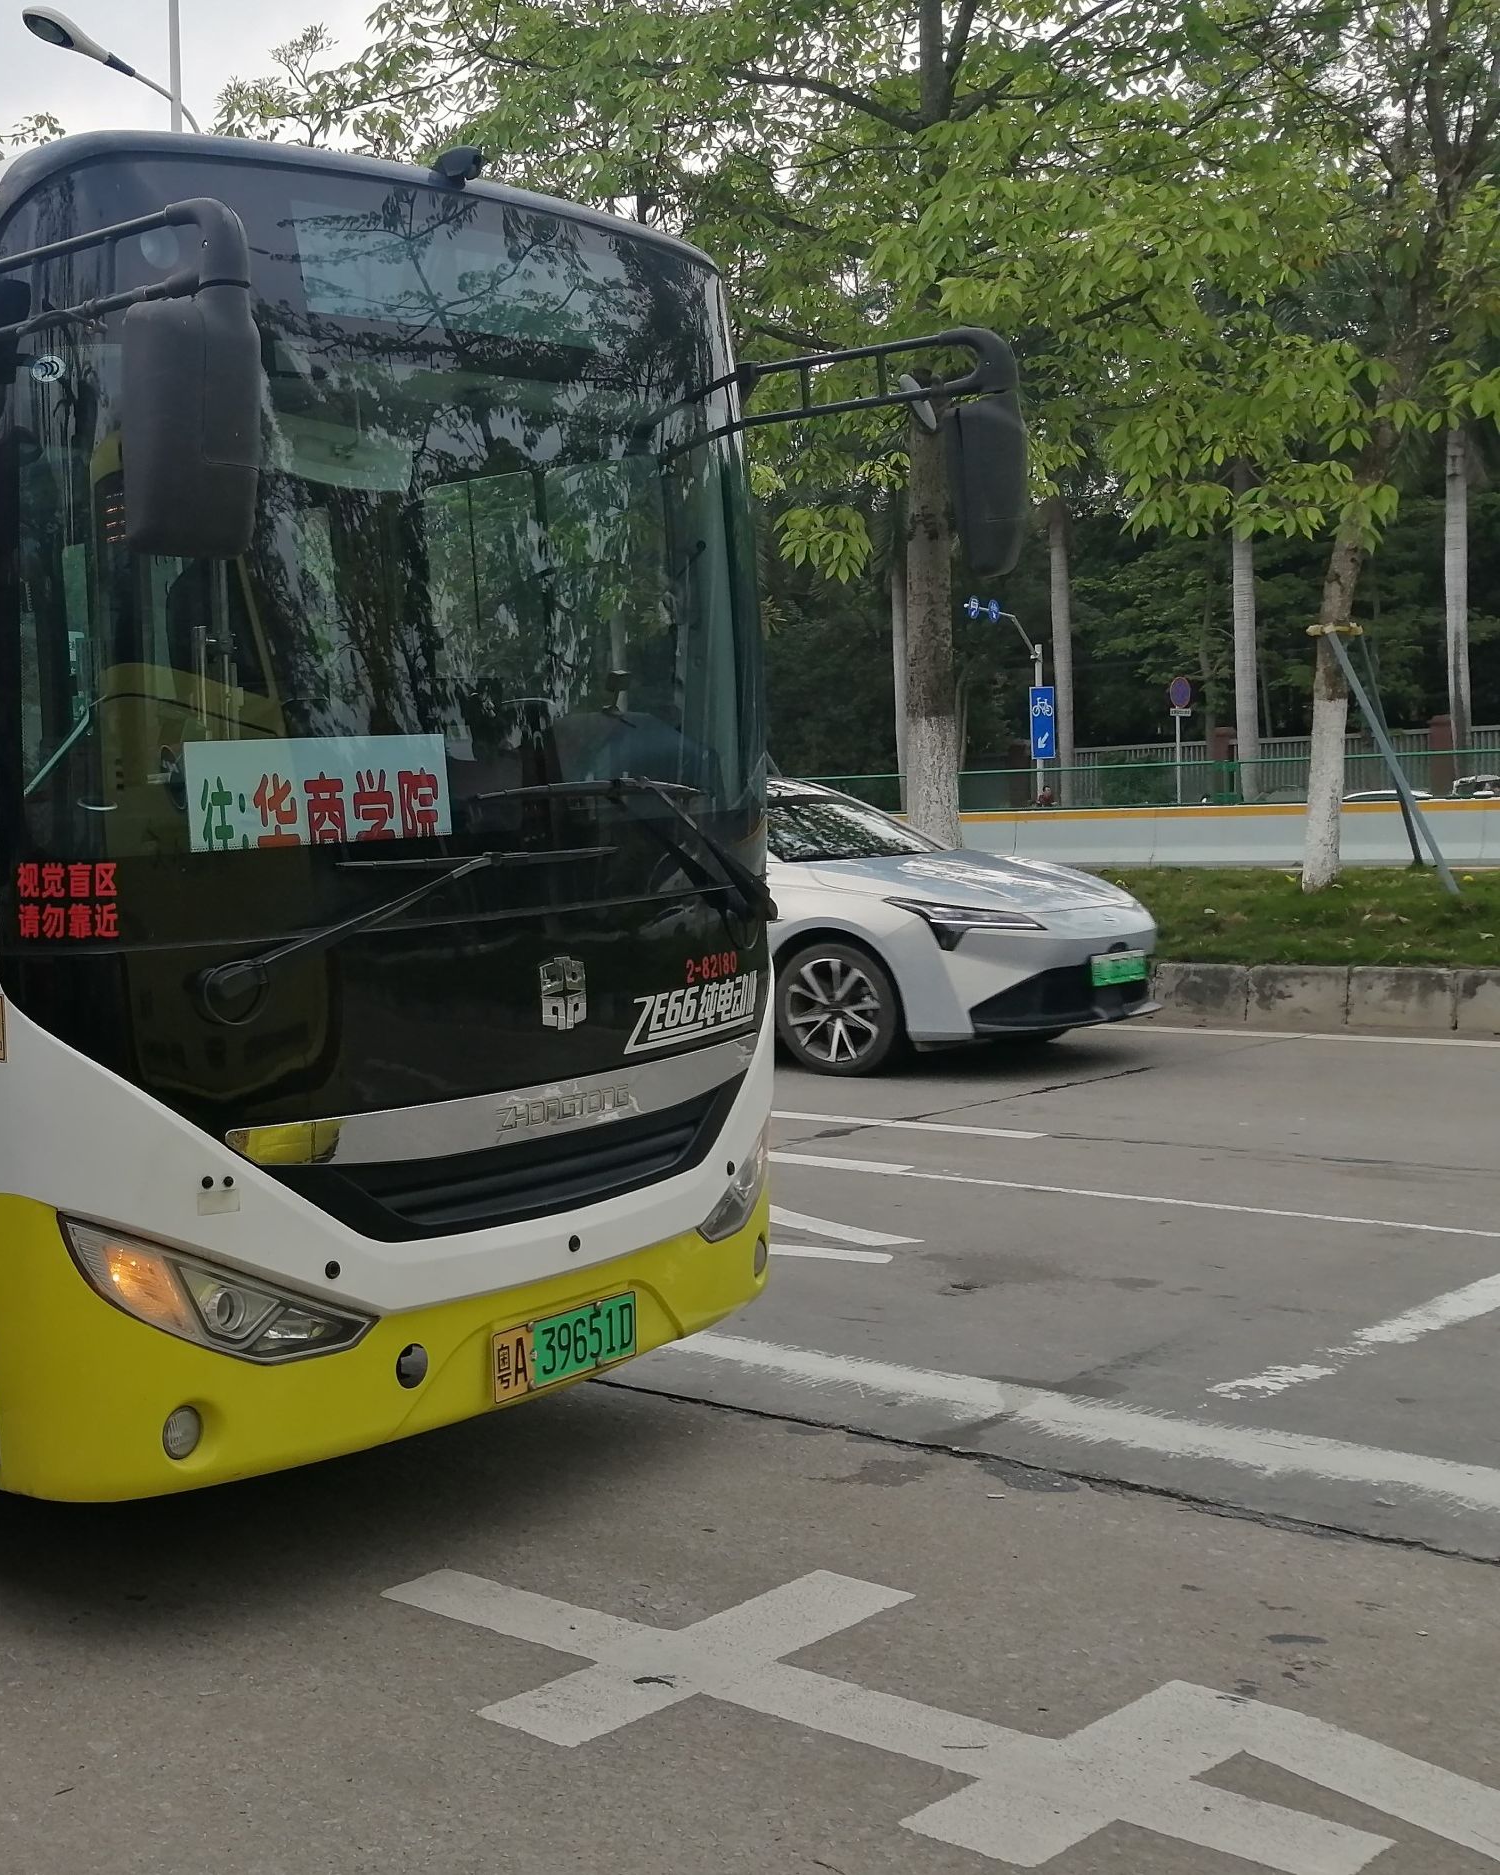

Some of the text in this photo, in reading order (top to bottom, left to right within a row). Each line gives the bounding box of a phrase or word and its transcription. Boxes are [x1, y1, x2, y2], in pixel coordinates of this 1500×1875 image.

[17, 862, 118, 898] 视觉盲区
[18, 902, 120, 938] 请勿靠近
[495, 1083, 629, 1132] ZHONGTONG
[541, 1302, 634, 1376] 39651D
